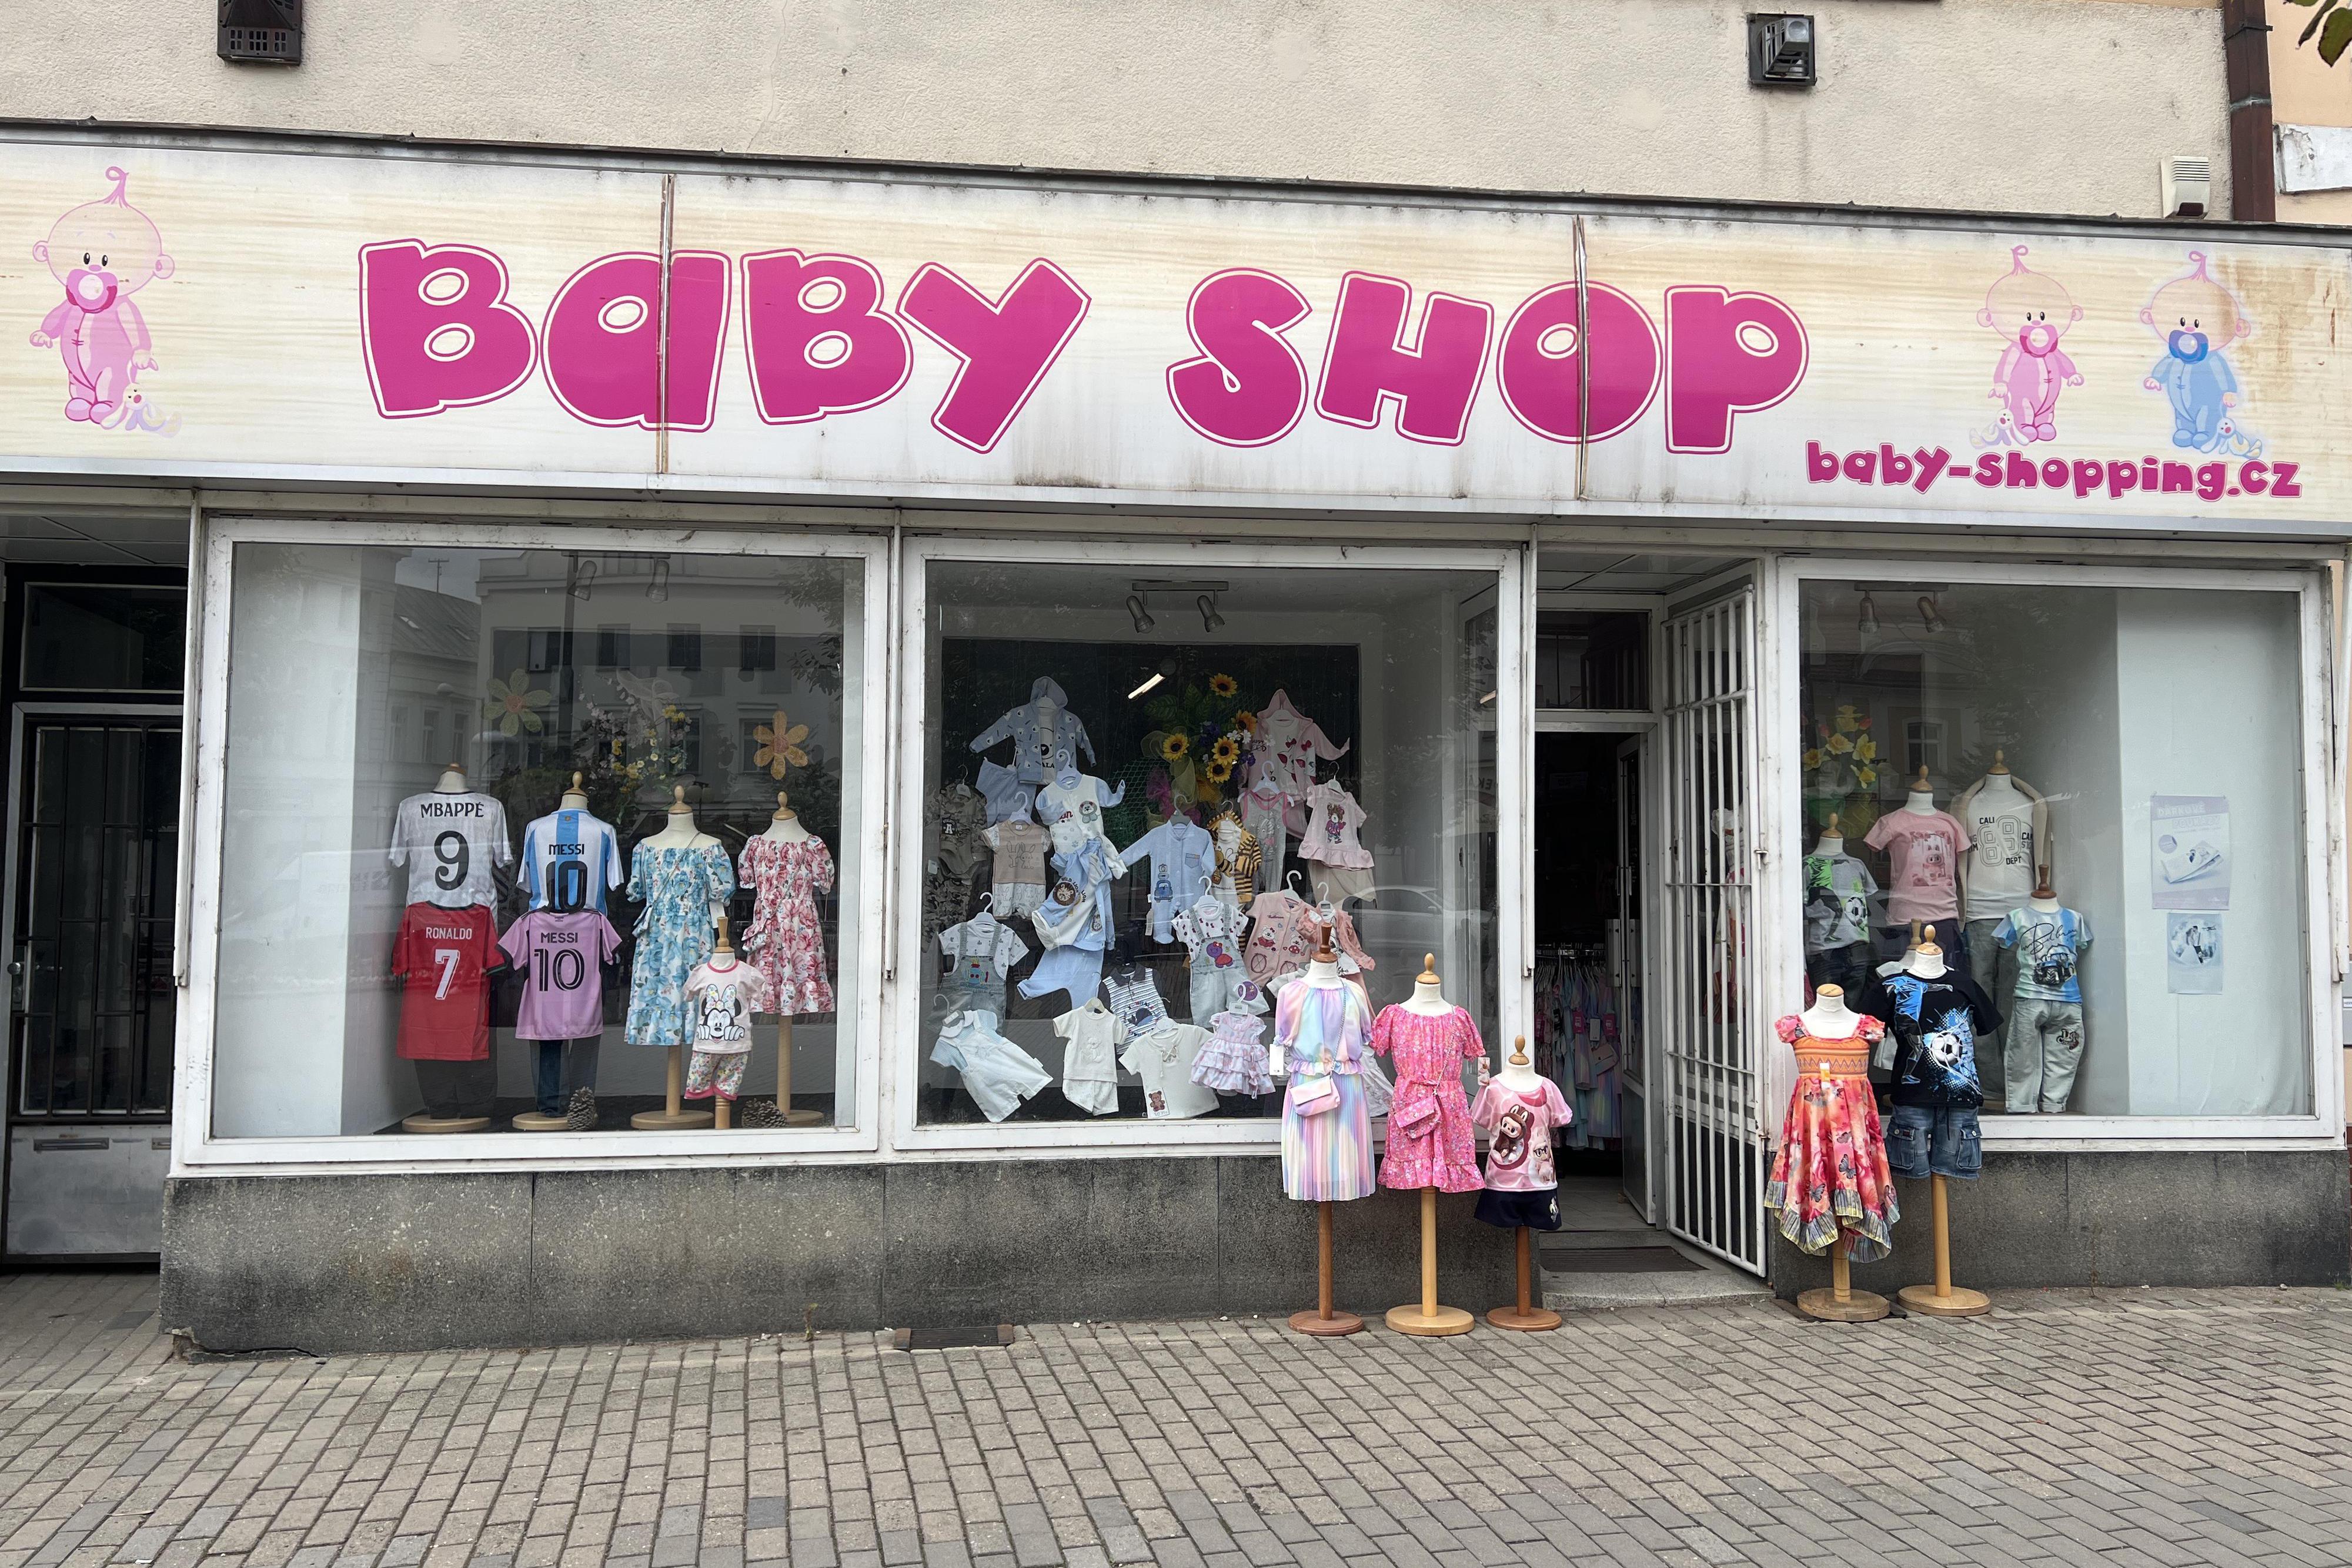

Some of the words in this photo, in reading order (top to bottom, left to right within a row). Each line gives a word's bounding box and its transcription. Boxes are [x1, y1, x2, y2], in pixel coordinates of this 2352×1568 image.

[1166, 267, 1809, 454] SHOP
[1806, 440, 2301, 502] baby-shopping.cz
[420, 802, 484, 818] MBAPPÉ
[433, 830, 469, 891] 9
[549, 844, 584, 855] MESSI
[2006, 856, 2022, 865] DEPT
[546, 861, 587, 911] 10
[426, 927, 472, 940] RONALDO
[541, 932, 578, 943] MESSI
[435, 949, 460, 1000] 7
[534, 948, 584, 992] 10
